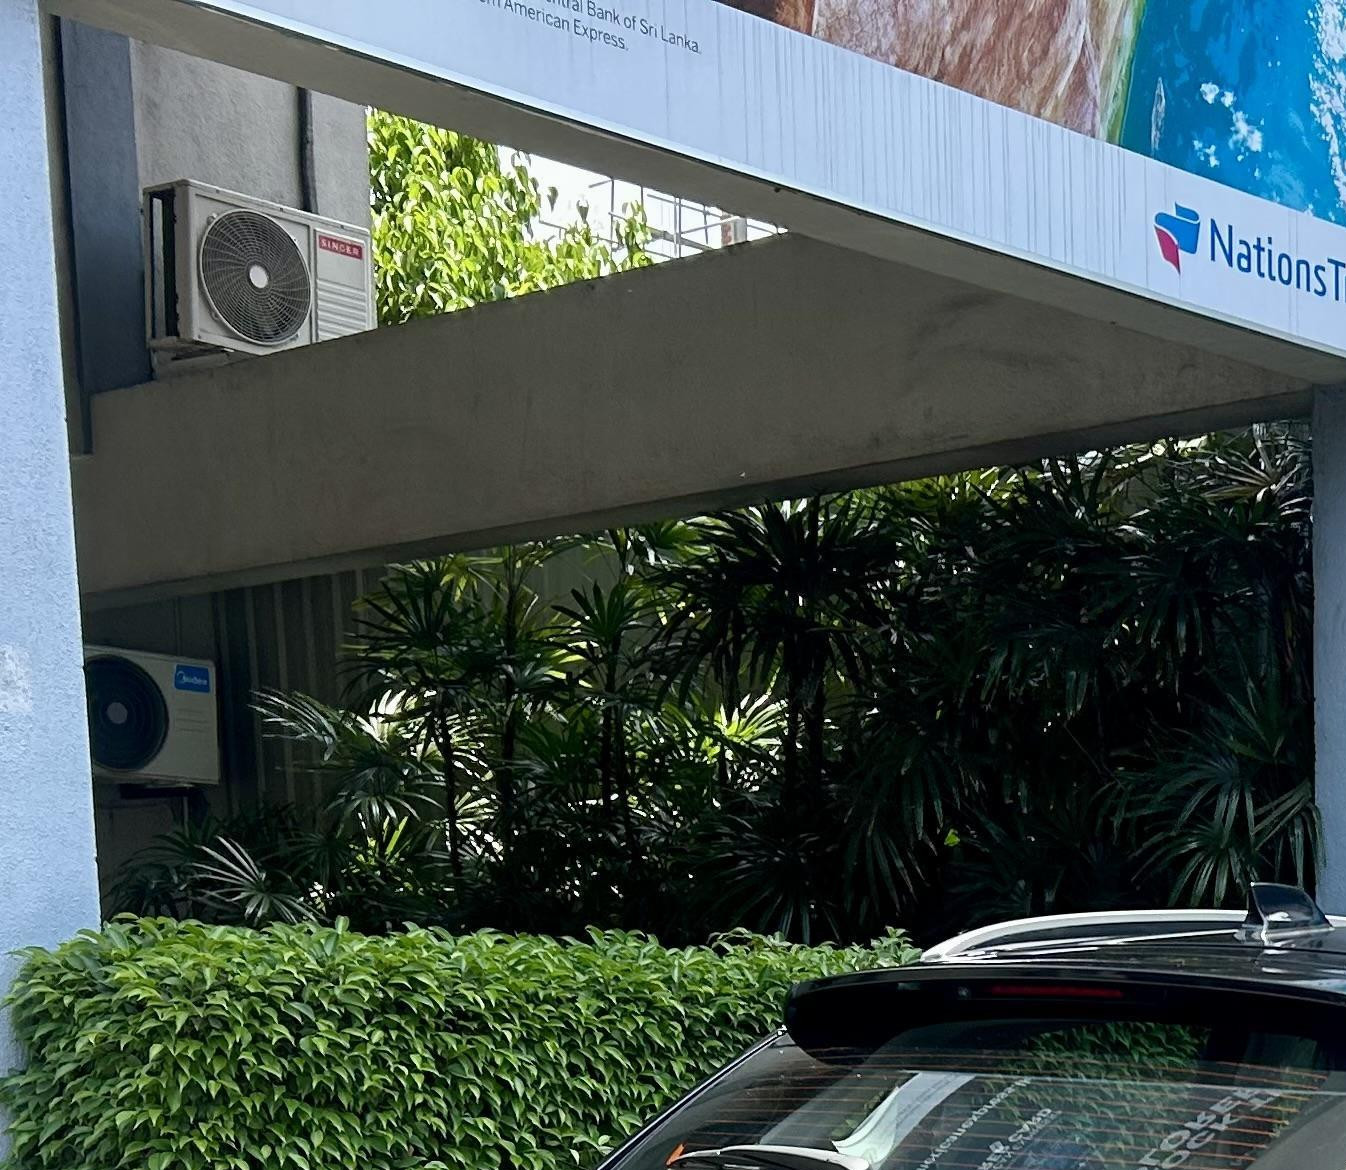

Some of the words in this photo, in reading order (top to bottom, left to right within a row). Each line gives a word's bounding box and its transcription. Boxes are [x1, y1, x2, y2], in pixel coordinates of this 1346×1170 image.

[504, 0, 570, 31] American
[587, 0, 620, 25] Bank
[624, 15, 637, 31] of
[640, 18, 658, 38] Sri
